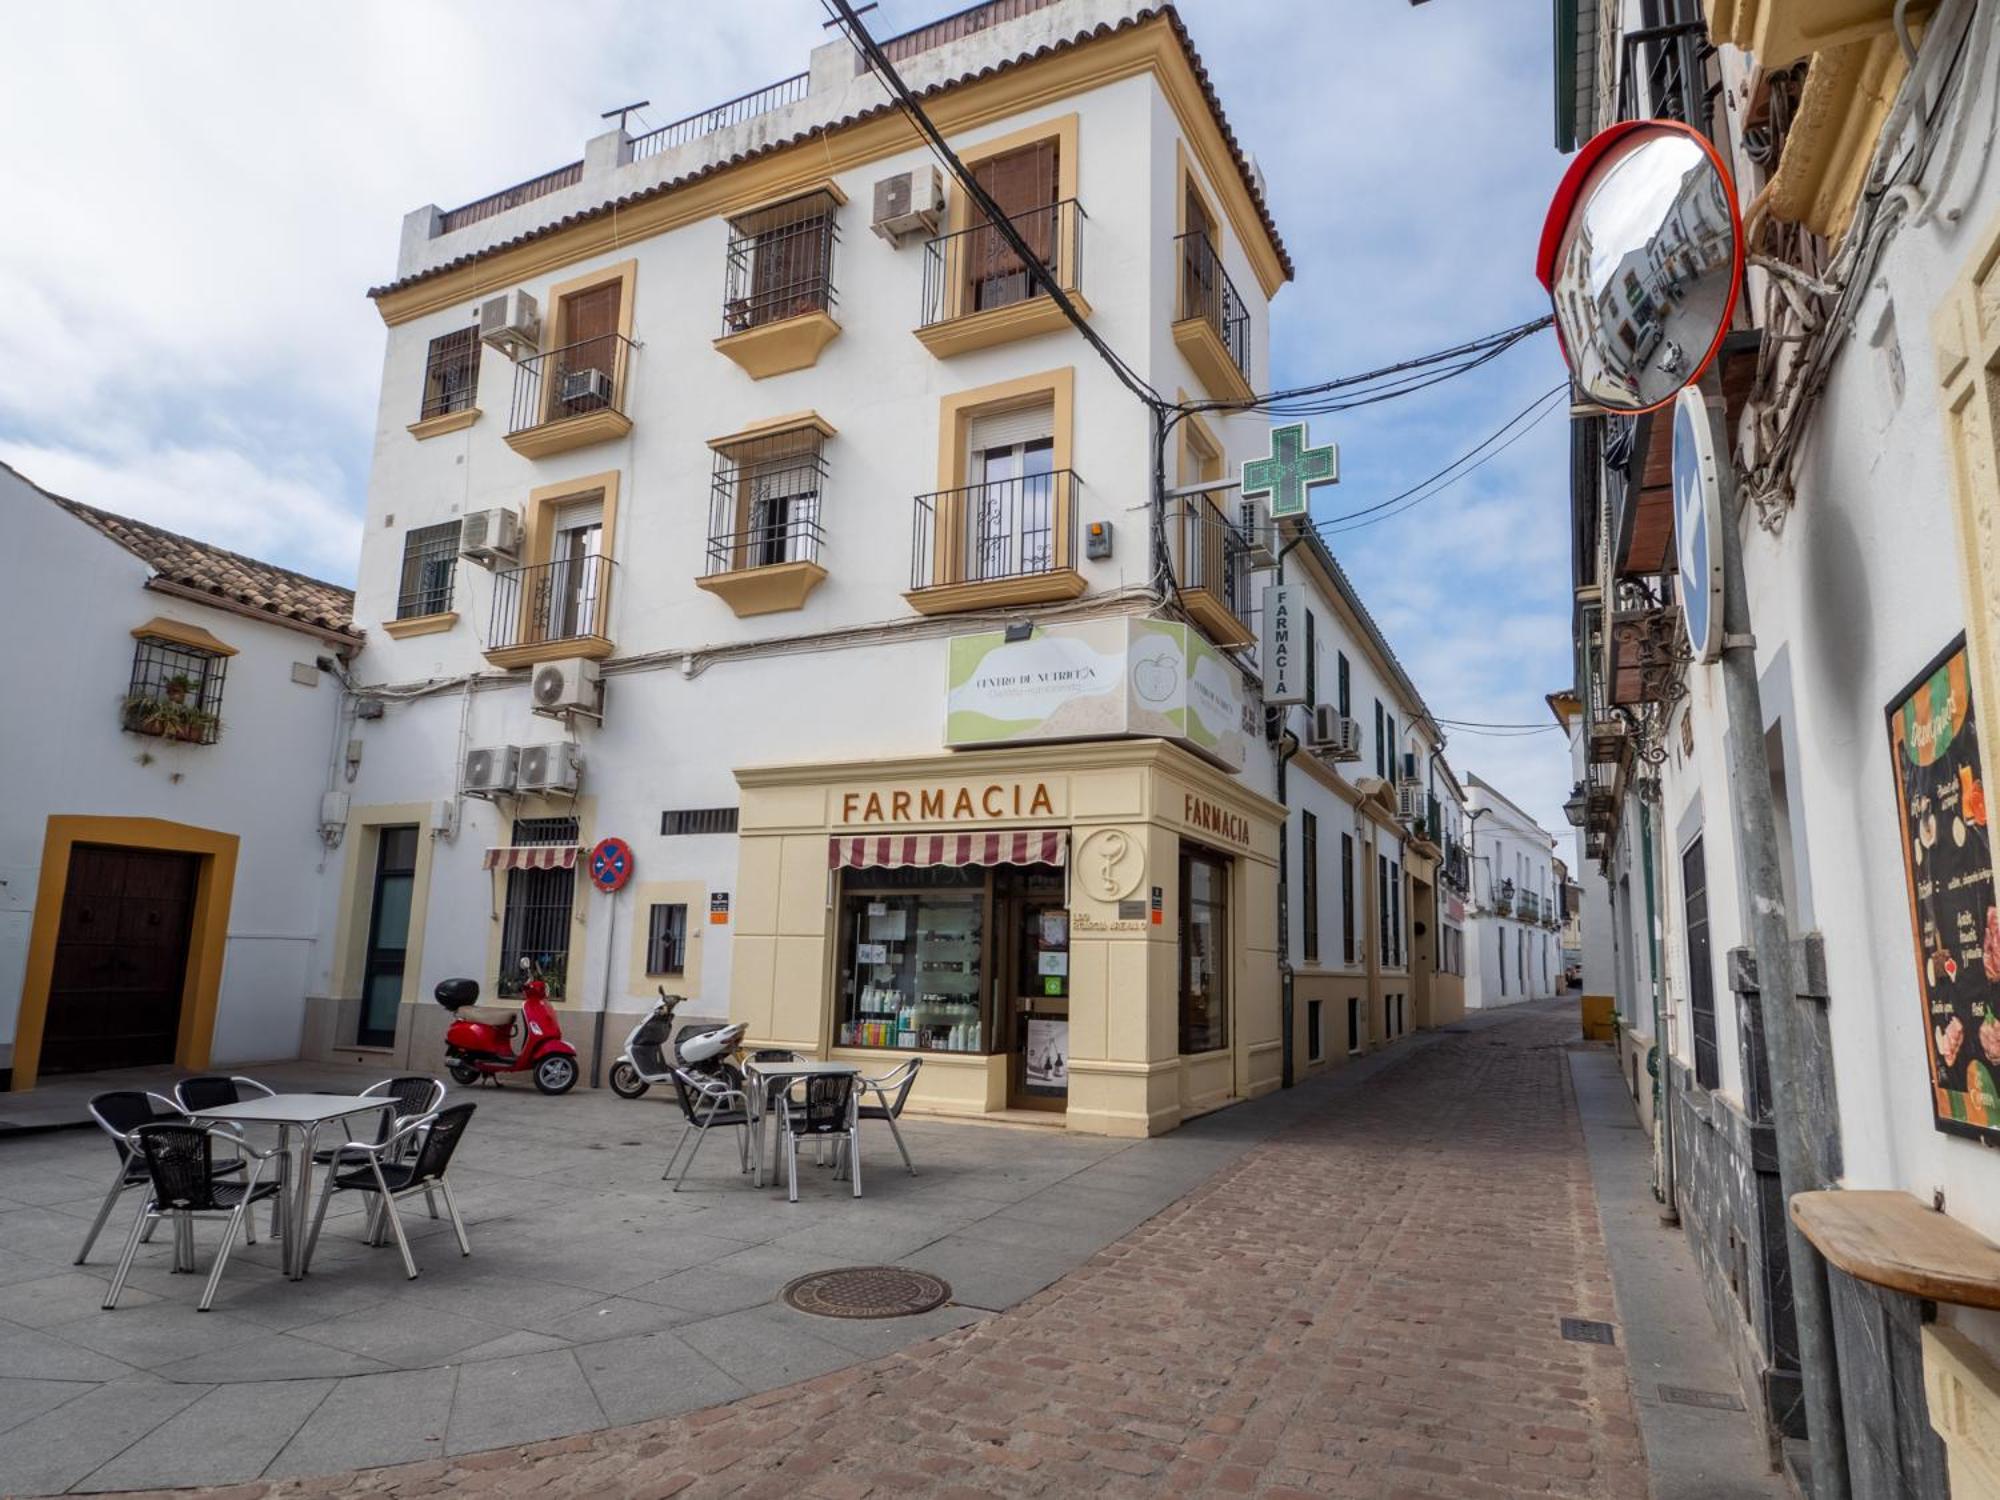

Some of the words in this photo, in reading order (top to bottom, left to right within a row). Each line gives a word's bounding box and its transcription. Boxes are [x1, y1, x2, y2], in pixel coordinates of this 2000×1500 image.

[1275, 592, 1289, 694] FARMACIA
[842, 782, 1054, 823] FARMACIA
[1184, 793, 1250, 846] FARMACIA
